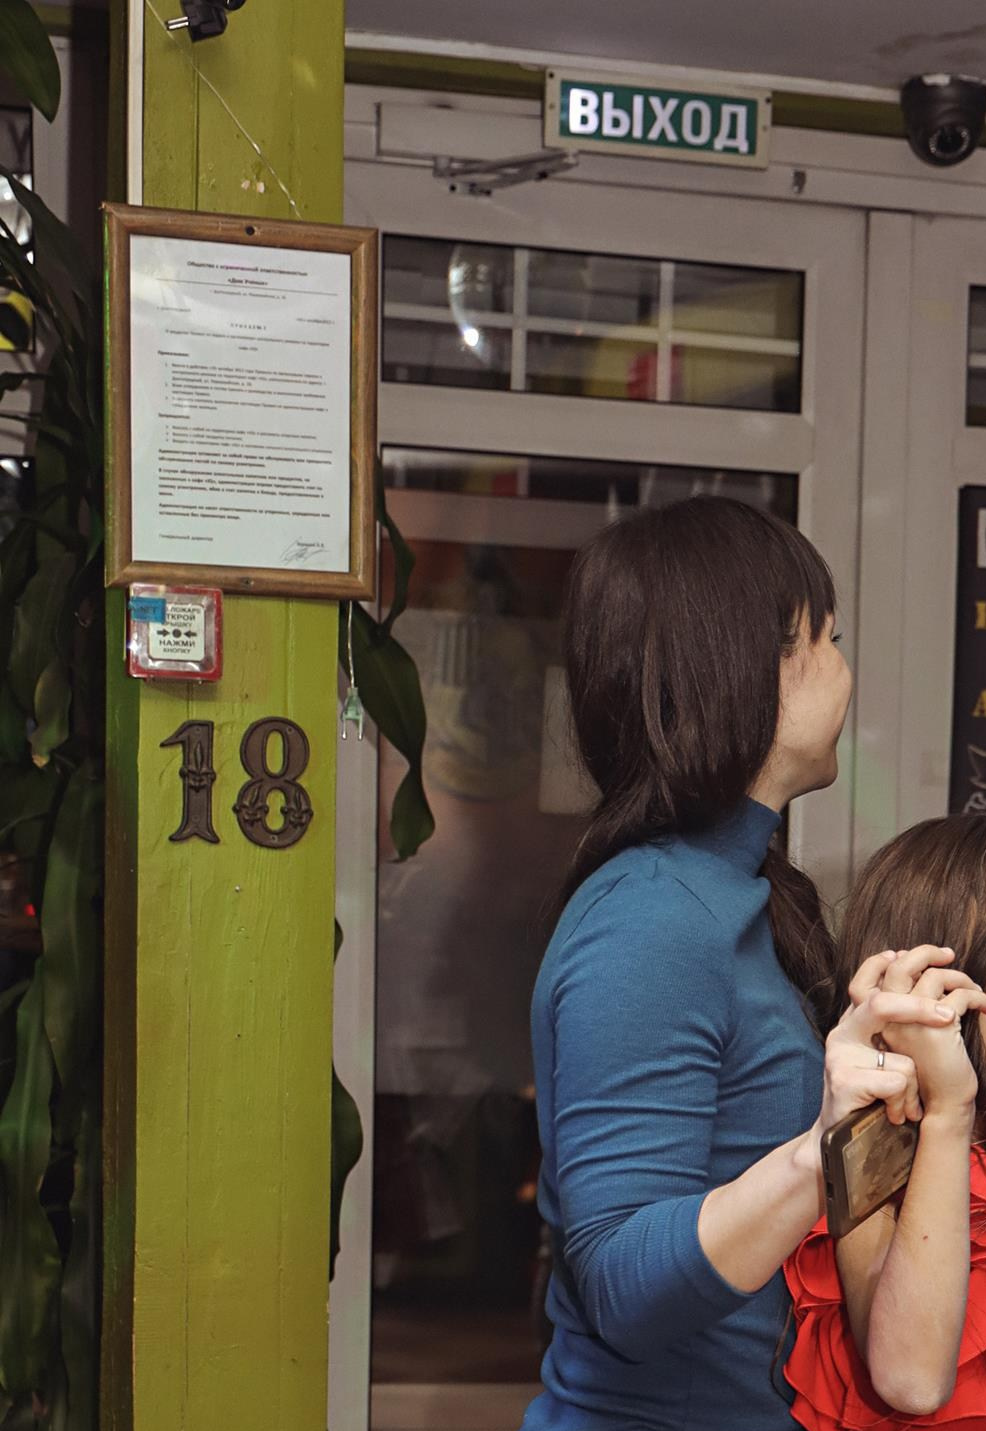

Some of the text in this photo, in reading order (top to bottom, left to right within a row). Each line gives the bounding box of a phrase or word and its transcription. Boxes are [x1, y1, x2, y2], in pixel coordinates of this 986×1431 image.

[569, 88, 749, 153] ВЫХОД
[166, 613, 196, 621] ТКРОЙ
[159, 640, 196, 648] НАЖМИ
[160, 716, 314, 849] 18
